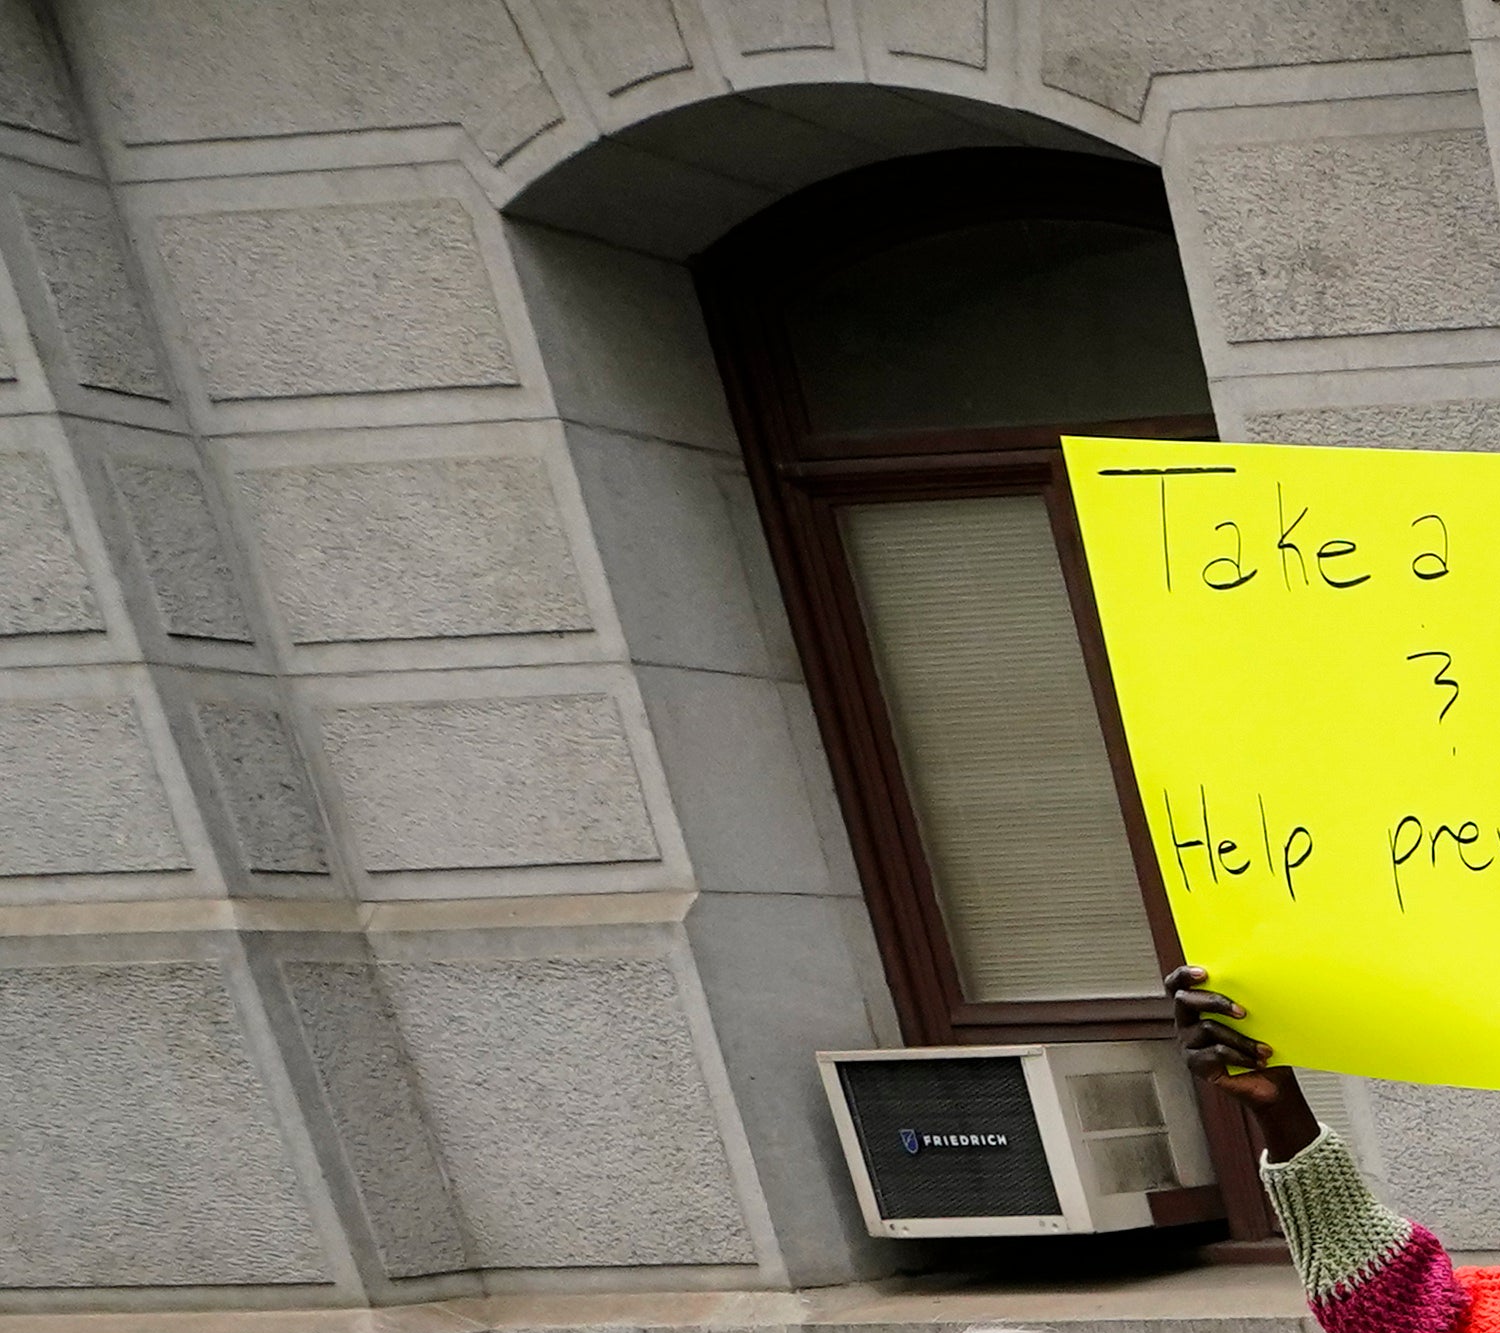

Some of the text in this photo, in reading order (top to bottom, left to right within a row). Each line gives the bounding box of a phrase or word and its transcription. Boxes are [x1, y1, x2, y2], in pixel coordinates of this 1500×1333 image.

[1098, 466, 1371, 592] Take
[1410, 514, 1451, 582] a
[1162, 784, 1313, 902] Help
[923, 1134, 1007, 1146] FRIEDRICH
